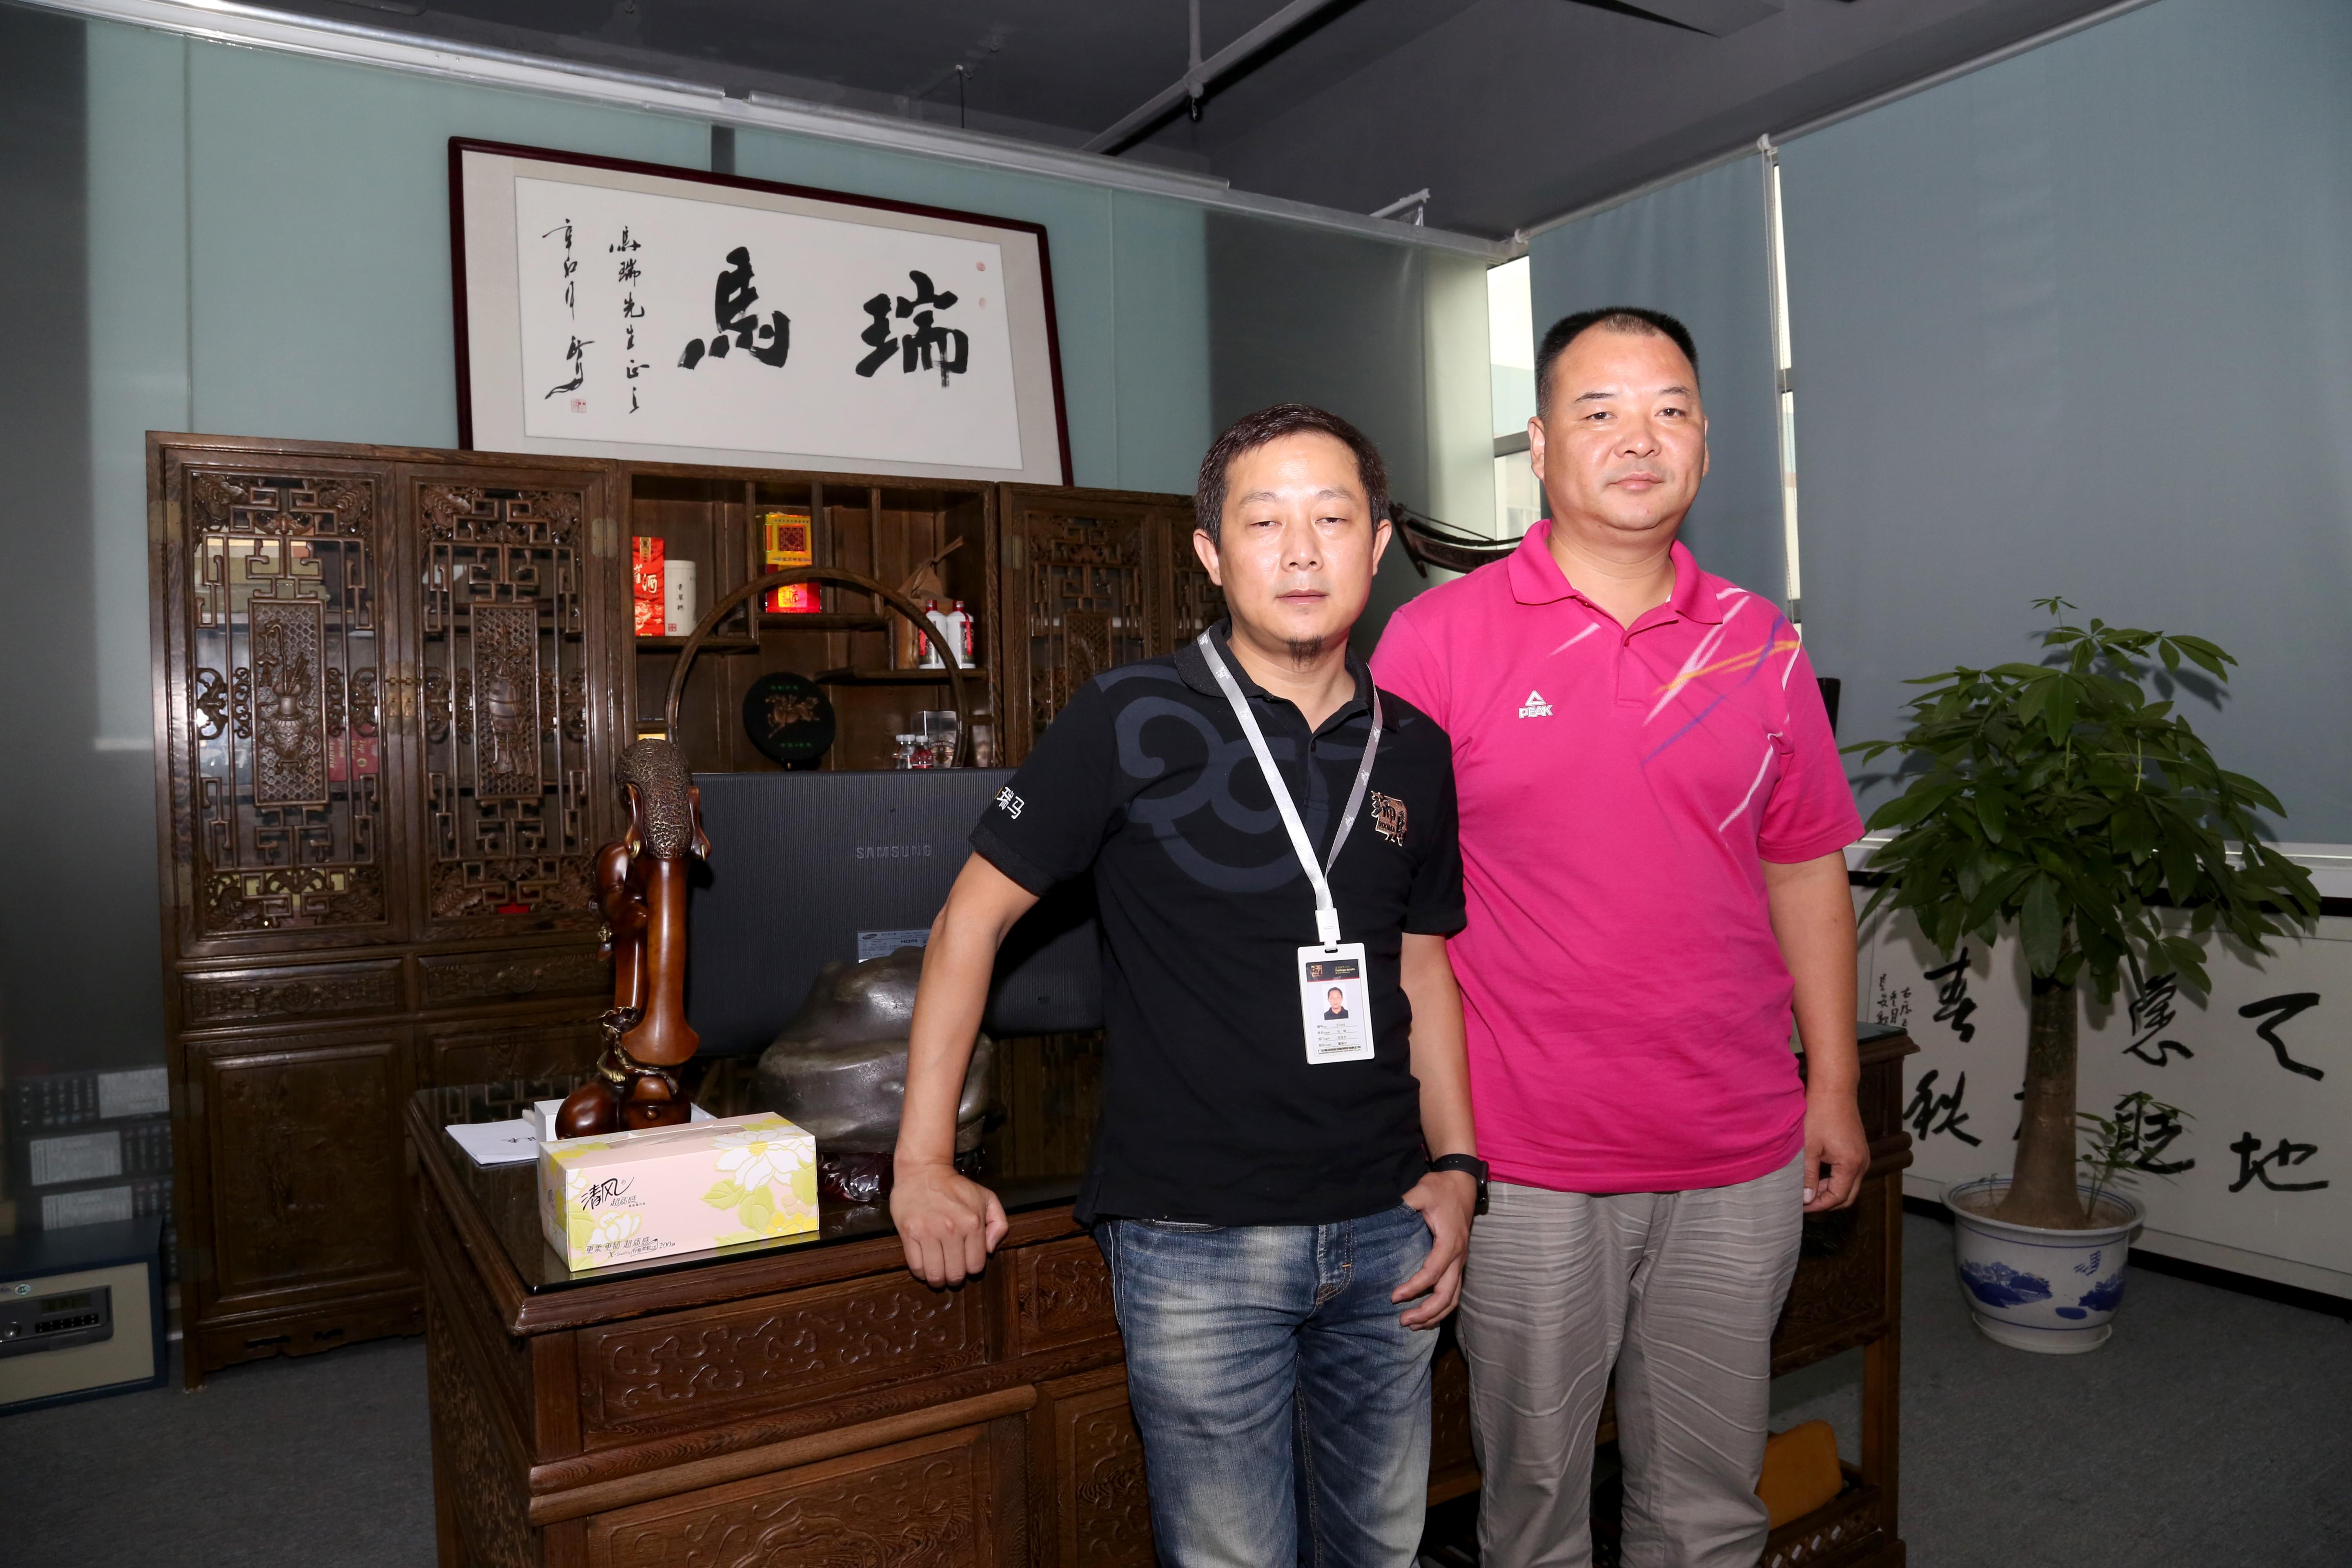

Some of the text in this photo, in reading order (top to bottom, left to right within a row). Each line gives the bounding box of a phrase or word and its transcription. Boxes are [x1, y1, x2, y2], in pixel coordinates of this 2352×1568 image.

[1519, 705, 1553, 719] PEAK
[997, 786, 1025, 819] 瑞马
[856, 845, 932, 860] SAMSUNG
[581, 1176, 635, 1211] 清风
[610, 1195, 637, 1208] 超质感
[586, 1236, 650, 1254] 更柔 更韧 超质感
